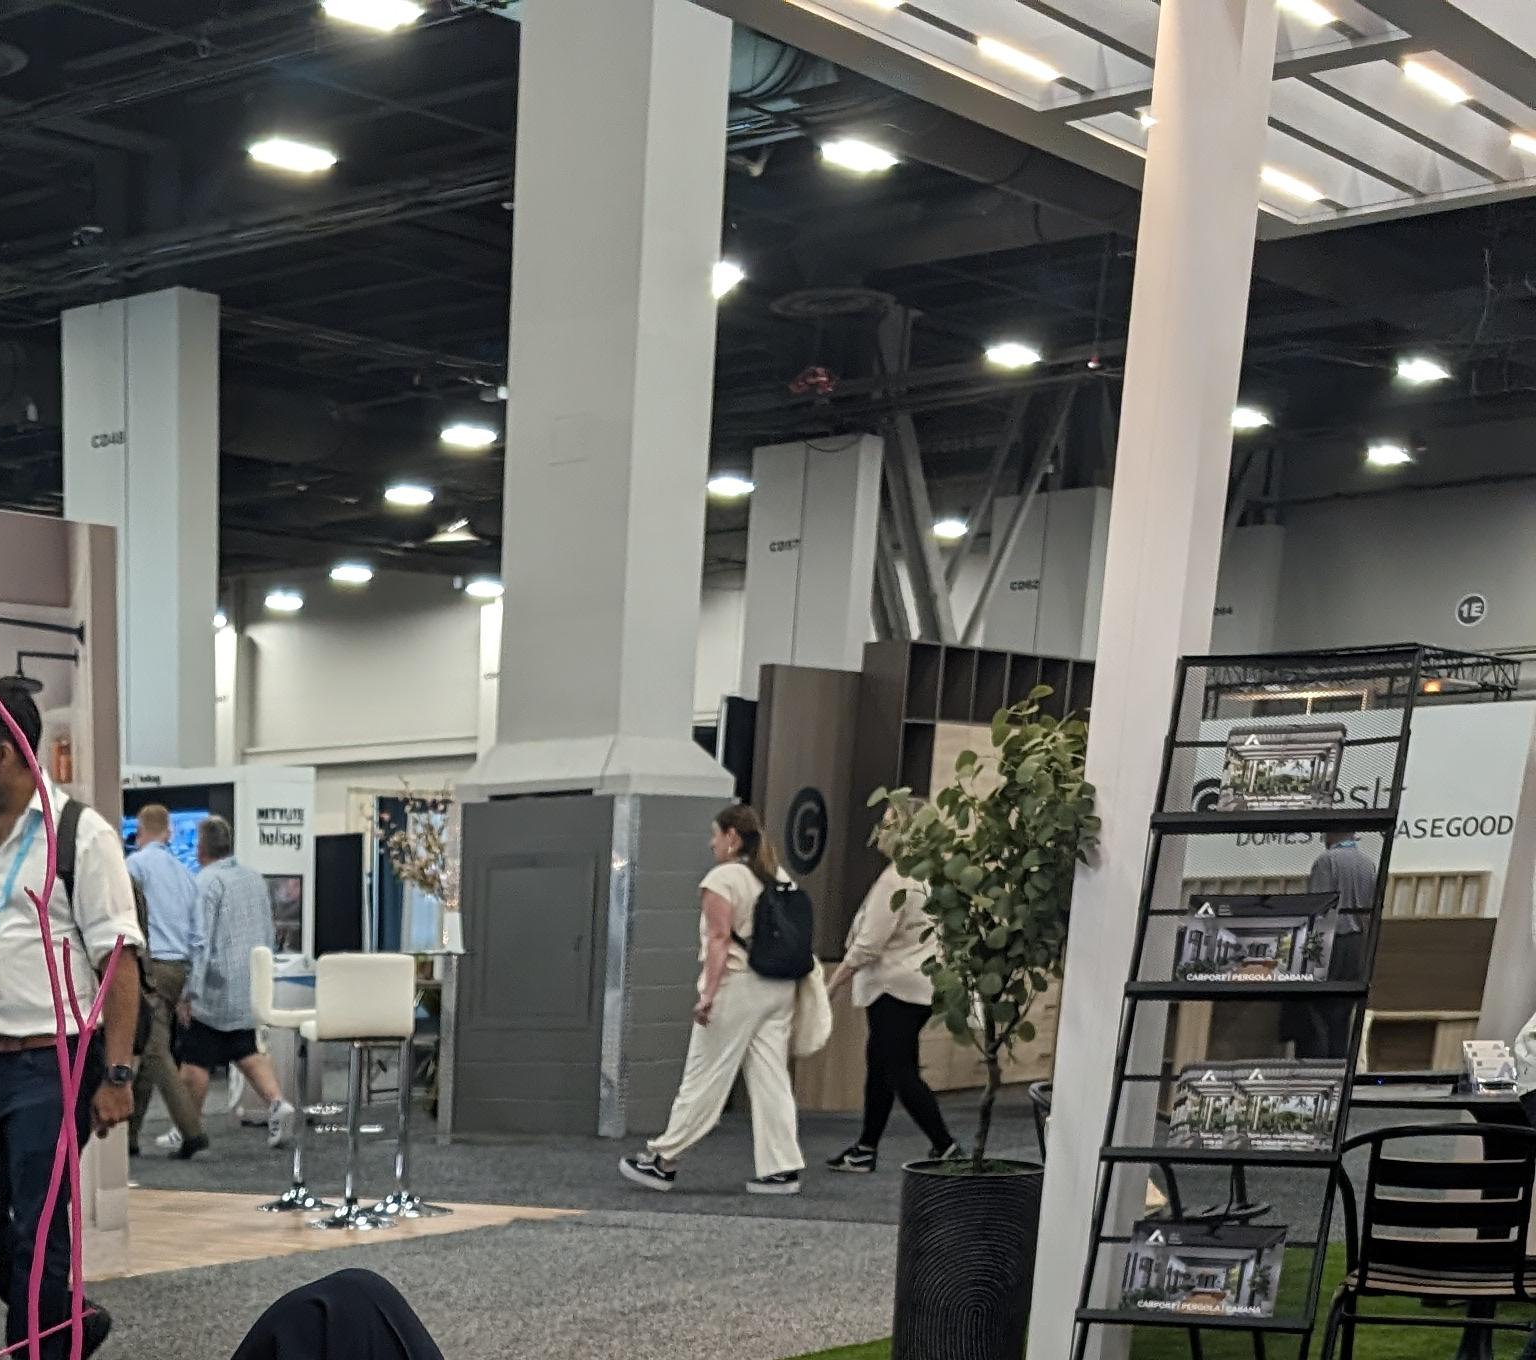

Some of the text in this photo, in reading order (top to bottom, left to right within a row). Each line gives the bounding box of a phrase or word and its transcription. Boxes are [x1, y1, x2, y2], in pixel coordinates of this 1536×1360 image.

[1460, 602, 1483, 618] 1E
[793, 801, 821, 861] G
[1395, 815, 1514, 840] ASEGOOD
